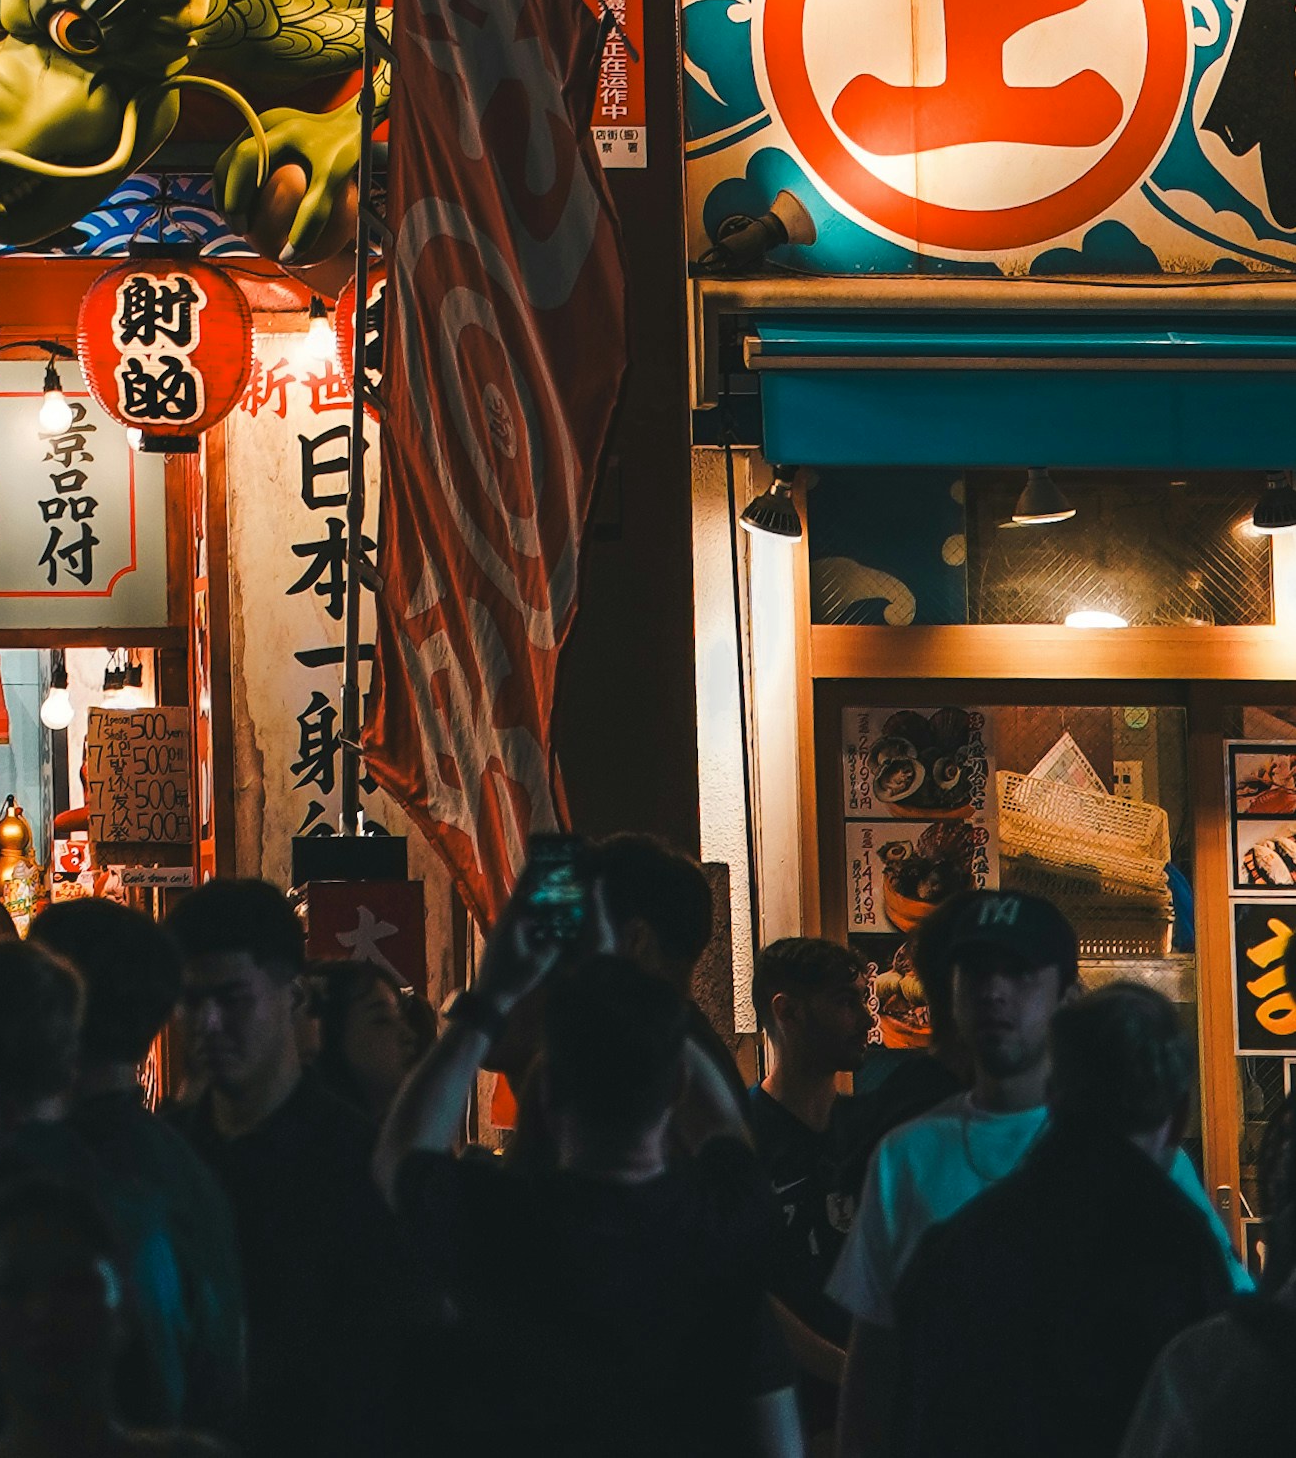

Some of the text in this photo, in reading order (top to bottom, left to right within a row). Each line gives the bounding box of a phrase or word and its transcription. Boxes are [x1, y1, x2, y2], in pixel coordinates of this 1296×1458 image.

[111, 271, 209, 425] 射的
[36, 401, 99, 588] 景品付
[89, 713, 103, 739] 7
[88, 745, 103, 773] 7
[89, 781, 104, 809] 7
[90, 814, 105, 841] 7
